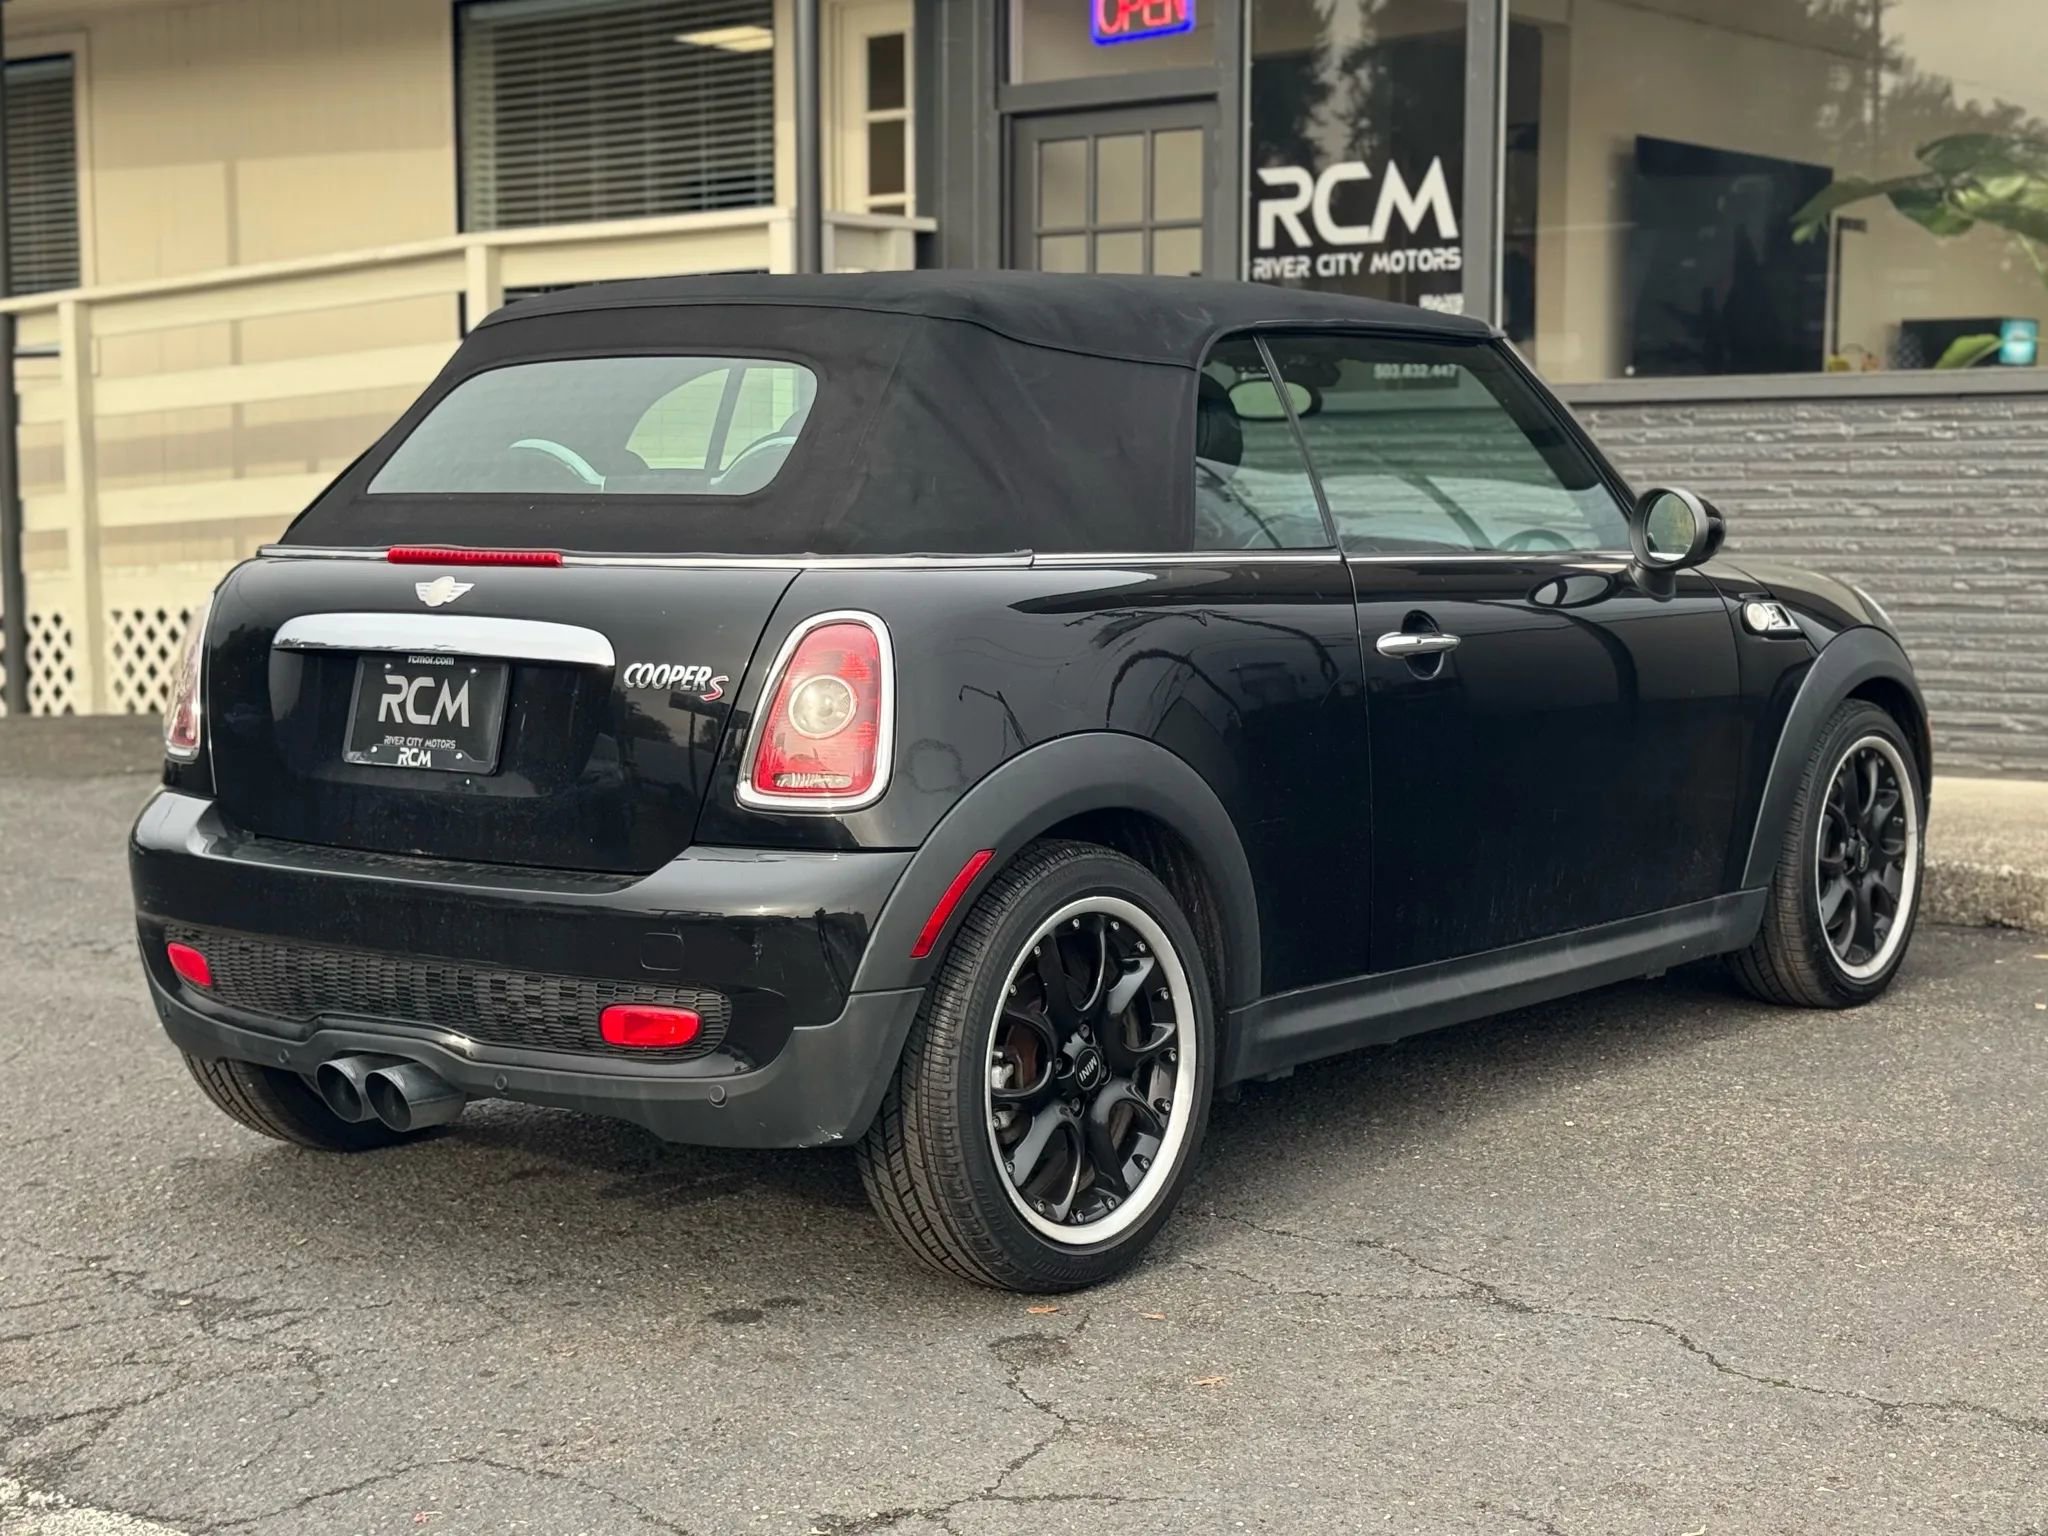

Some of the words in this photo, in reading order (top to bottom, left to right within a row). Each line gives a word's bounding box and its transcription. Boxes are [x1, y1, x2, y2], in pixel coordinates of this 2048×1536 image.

[1257, 155, 1459, 249] RCM
[1252, 254, 1312, 280] RIVER
[1315, 252, 1363, 277] CITY
[1370, 247, 1462, 274] MOTORS
[407, 655, 455, 666] rcmor.com
[623, 662, 712, 692] COOPER
[700, 675, 729, 702] S
[378, 674, 470, 728] RCM
[383, 735, 405, 746] RIVER
[406, 737, 423, 748] CITY
[424, 738, 456, 750] MOTORS
[397, 747, 432, 768] RCM
[1078, 1055, 1098, 1082] MINI
